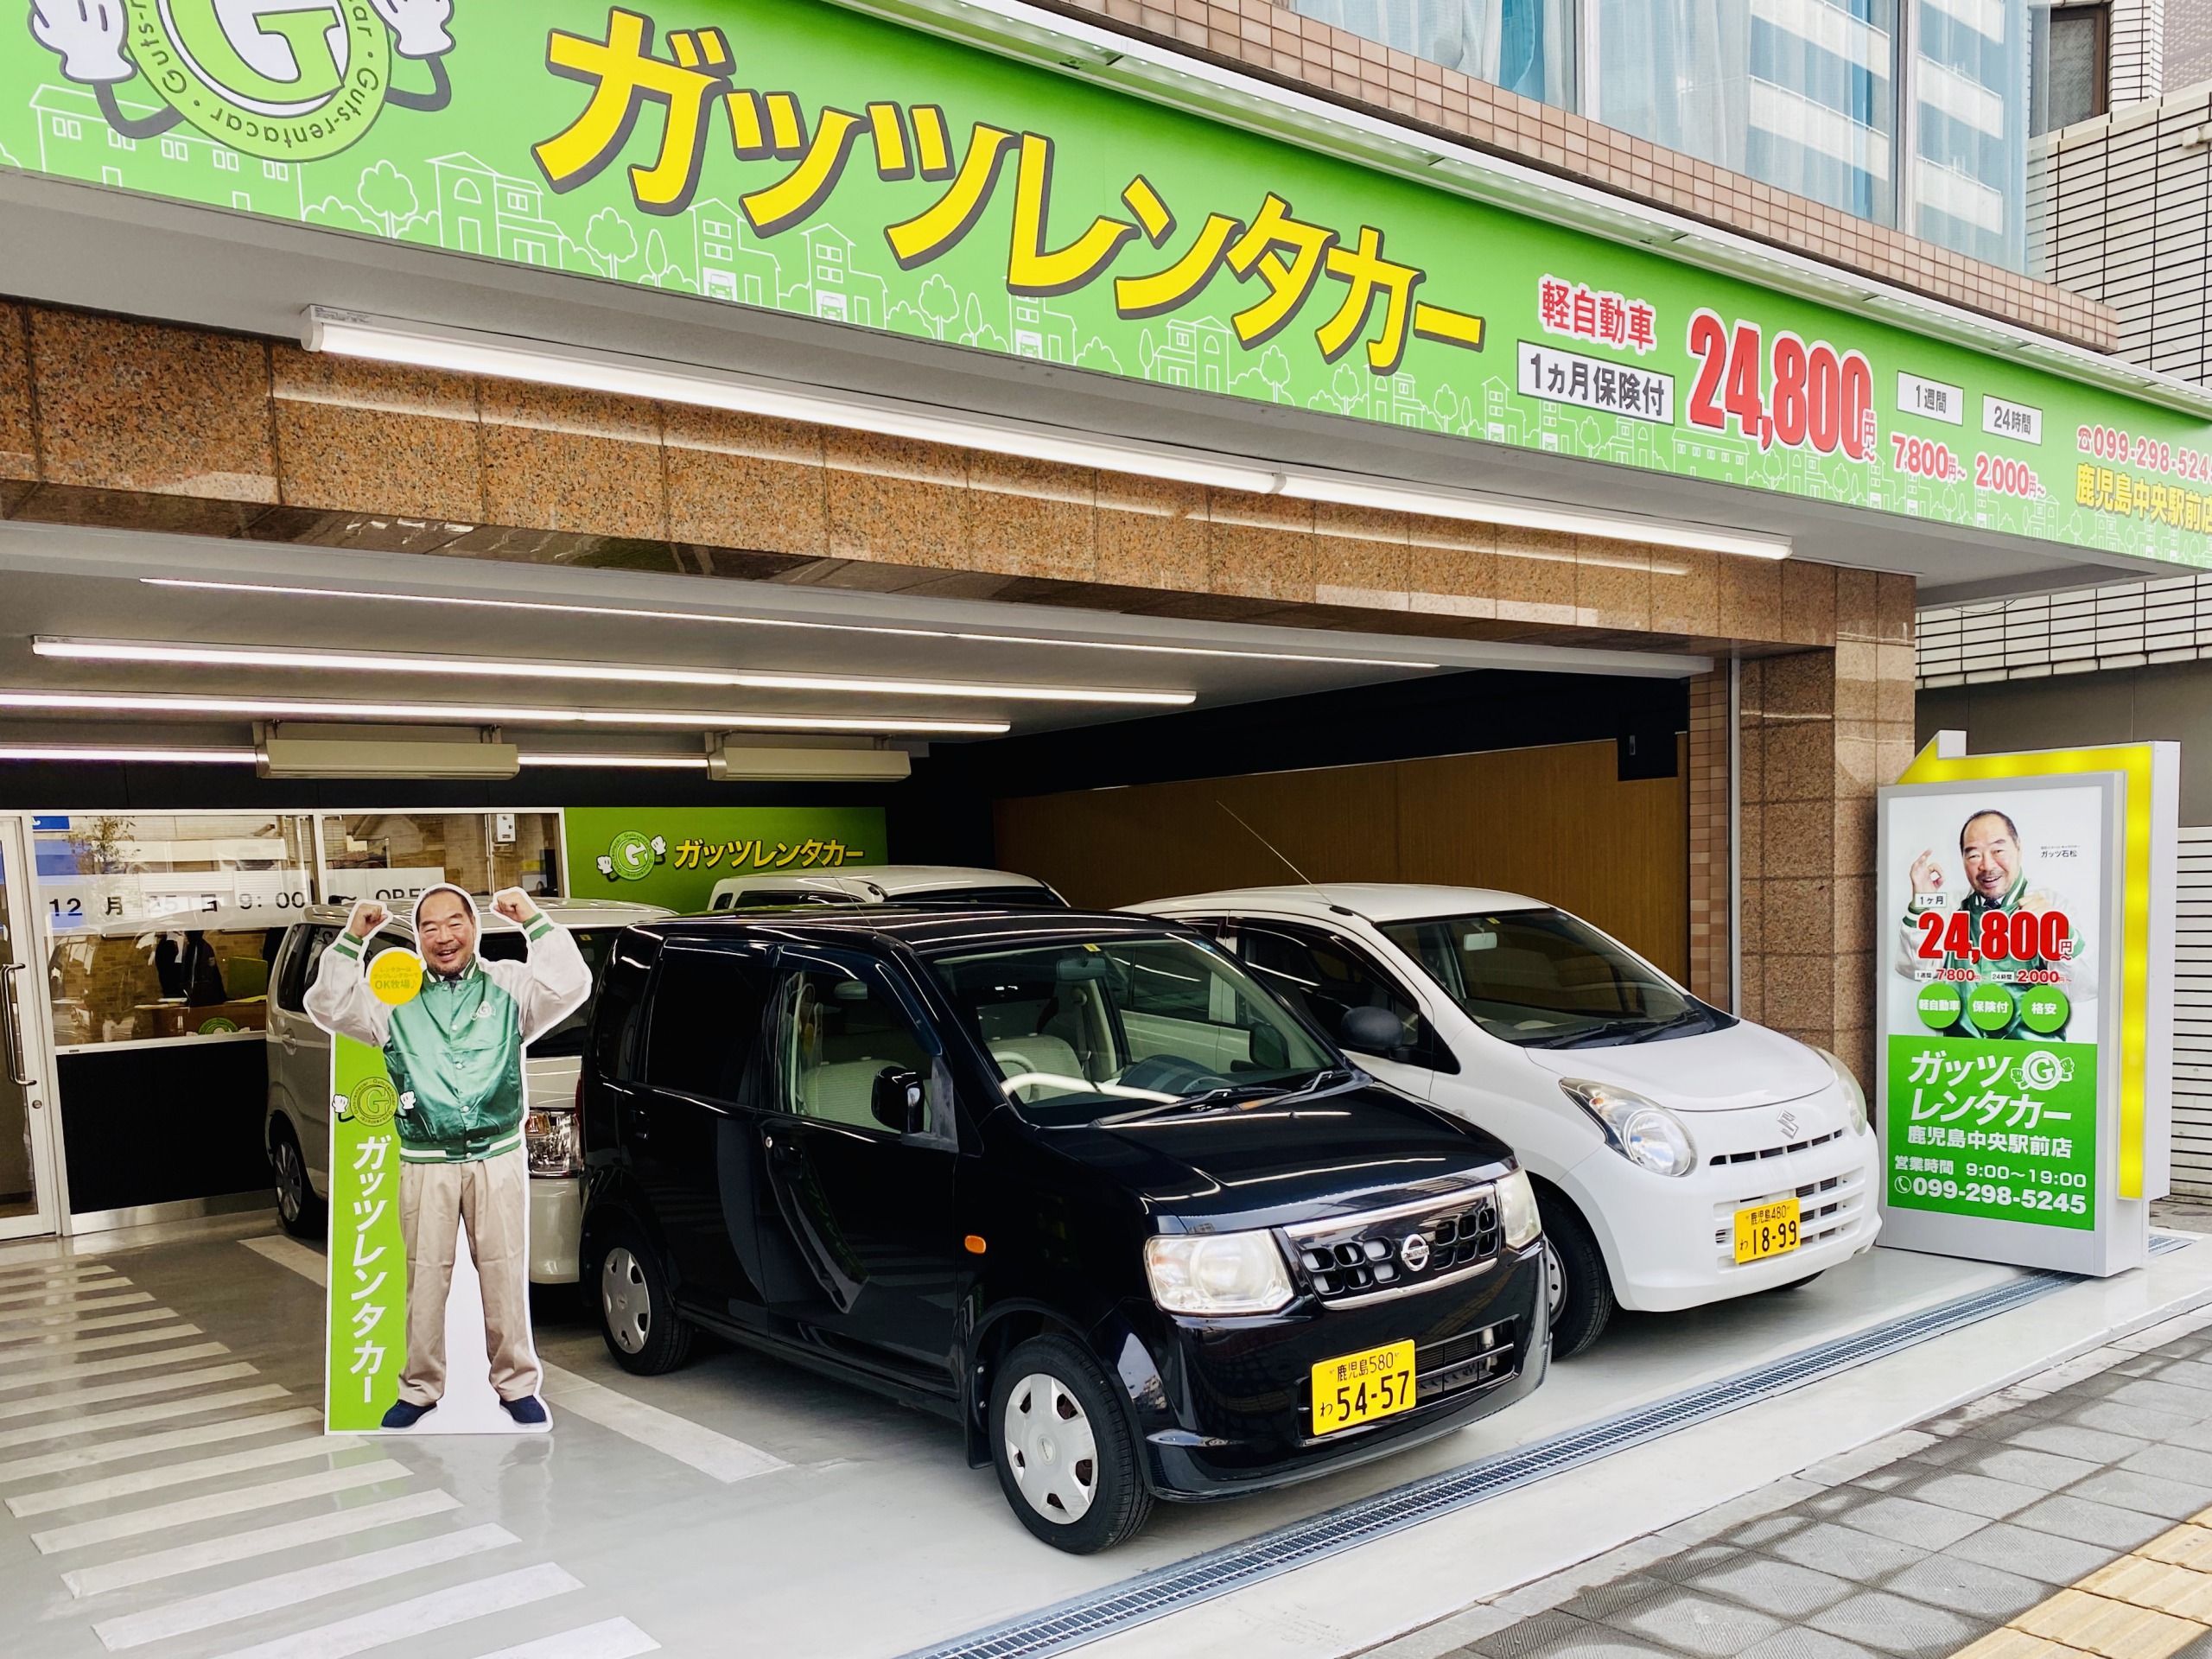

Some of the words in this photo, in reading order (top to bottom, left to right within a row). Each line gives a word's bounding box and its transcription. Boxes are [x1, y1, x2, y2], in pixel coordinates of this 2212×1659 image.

[210, 67, 379, 149] Guts-rentacar
[531, 6, 1485, 372] ガッツレンタカー
[1541, 280, 1655, 349] 軽自動車
[1993, 405, 2031, 435] 24時間
[674, 837, 865, 869] ガッツレンタカー
[1918, 999, 1961, 1012] 軽自動車
[1973, 1000, 2009, 1014] 保険付
[2031, 1001, 2057, 1015] 格安
[1908, 1049, 2014, 1088] ガッツ
[1910, 1088, 2072, 1129] レンタカー
[1908, 1125, 2073, 1159] 鹿児島中央駅前店
[1894, 1155, 1954, 1176] 営業時間
[1912, 1177, 2087, 1214] 099-298-5245
[1753, 1220, 1797, 1255] 18-99
[350, 1134, 391, 1403] ガッツレンタカー
[1319, 1401, 1333, 1418] わ
[1337, 1370, 1410, 1422] 54-57
